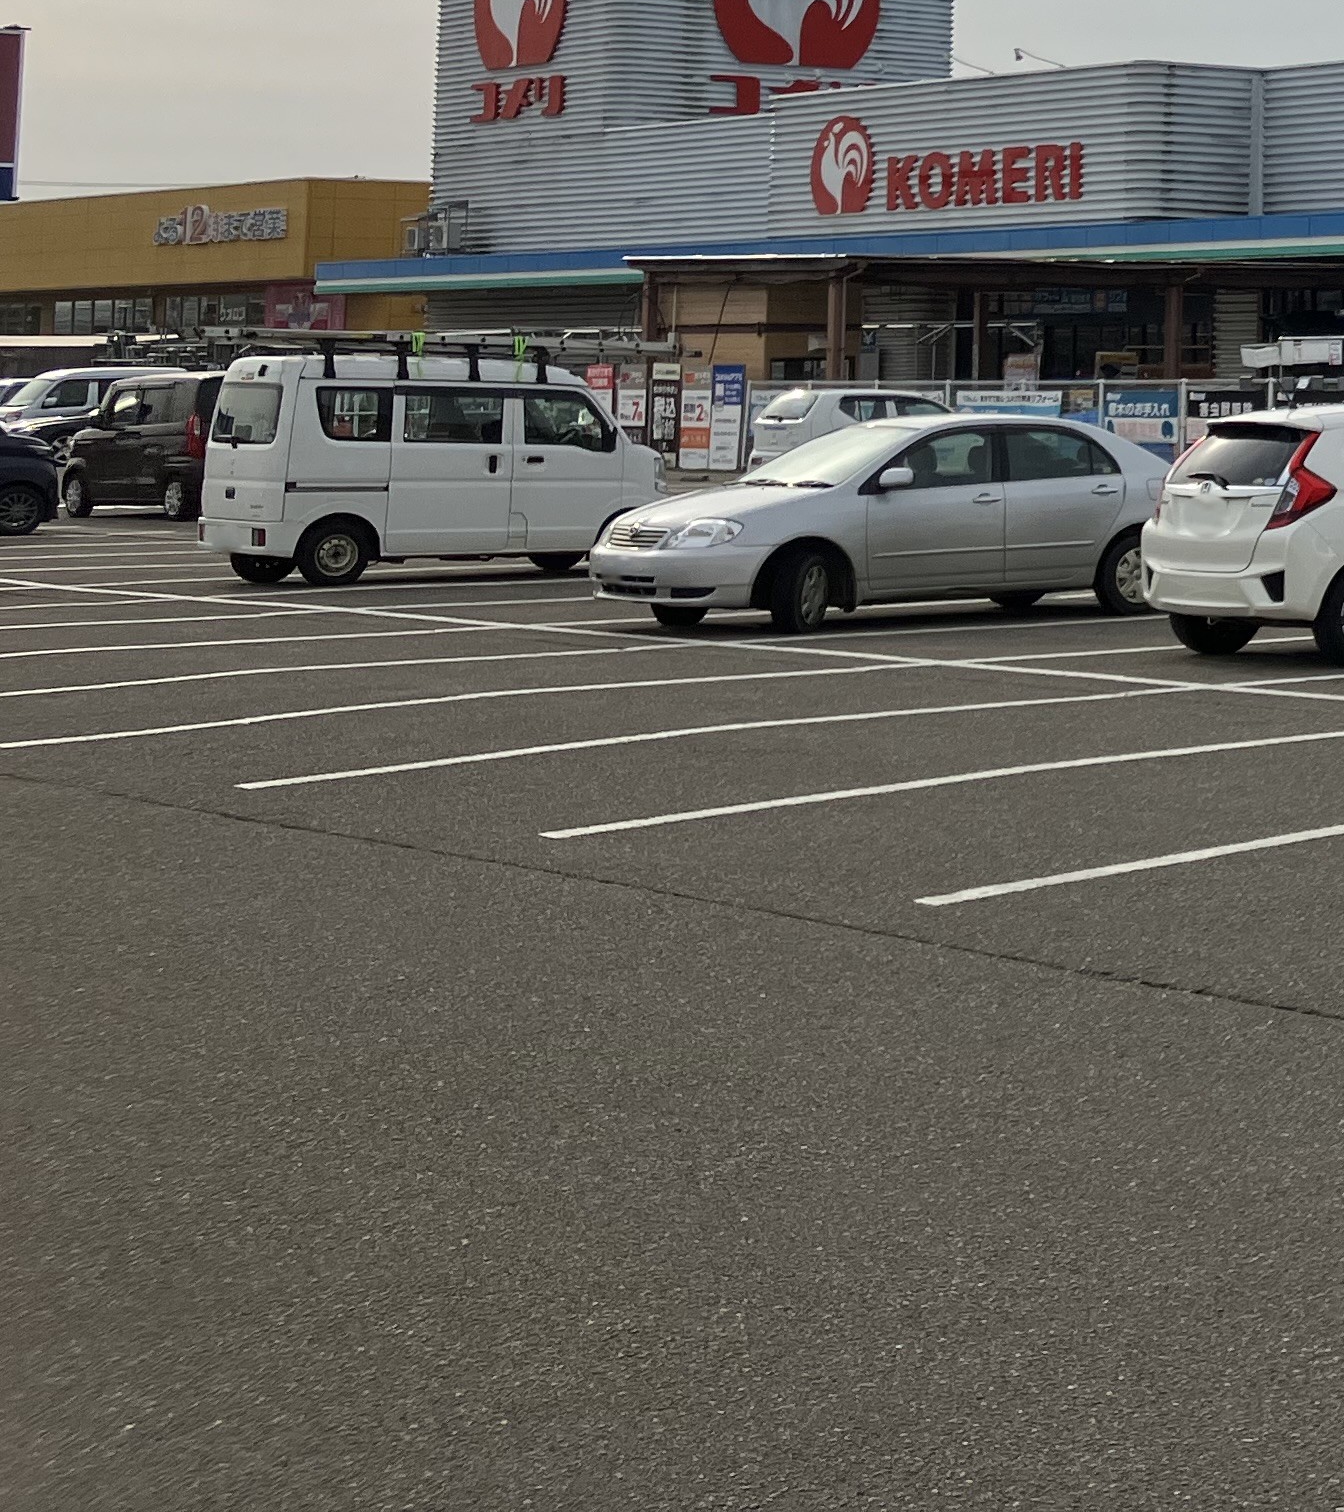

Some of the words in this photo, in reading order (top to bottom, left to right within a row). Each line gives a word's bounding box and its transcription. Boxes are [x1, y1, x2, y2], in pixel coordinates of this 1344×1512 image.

[470, 75, 567, 123] コメリ
[886, 142, 1084, 211] KOMERI
